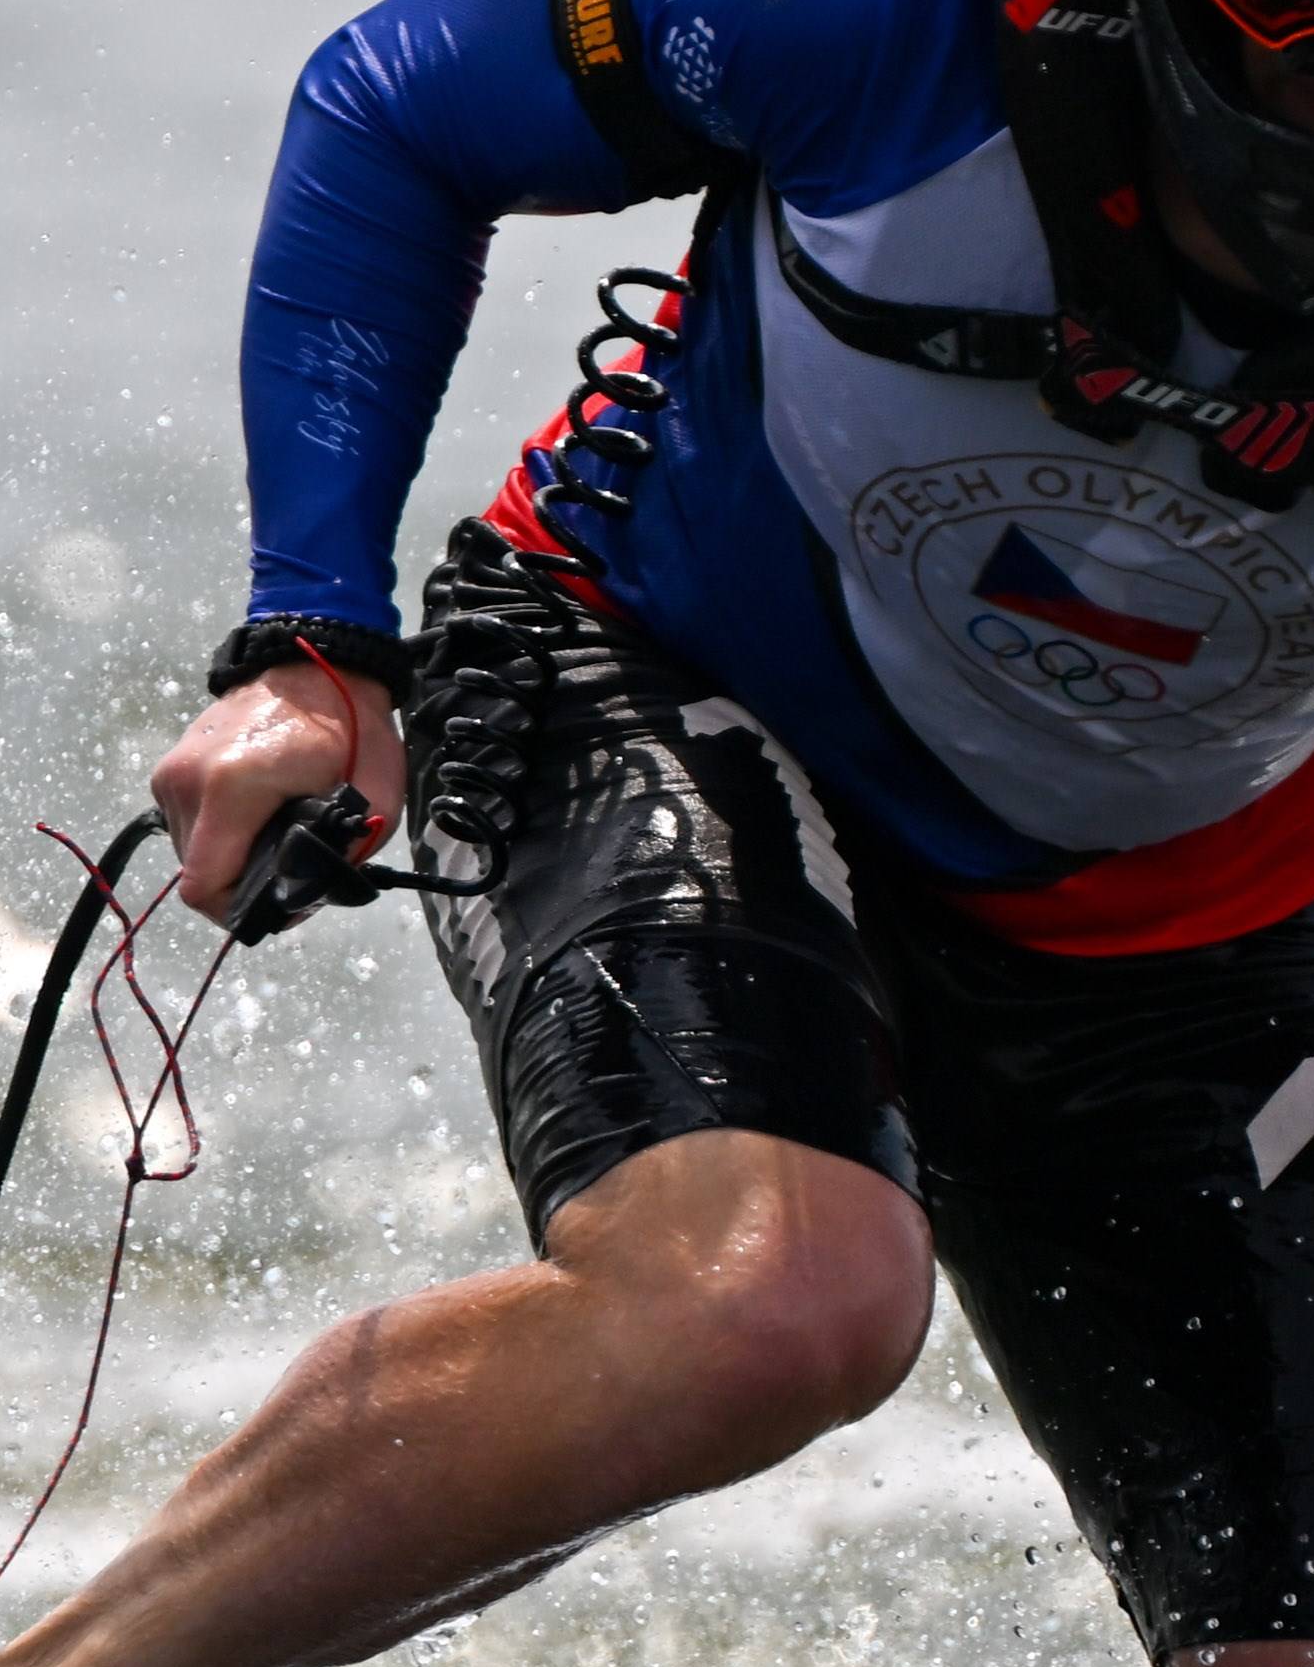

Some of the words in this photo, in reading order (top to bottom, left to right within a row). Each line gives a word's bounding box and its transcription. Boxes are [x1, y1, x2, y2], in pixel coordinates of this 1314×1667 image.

[1036, 7, 1133, 39] UFO
[1119, 377, 1239, 426] UFO
[861, 466, 1003, 558] CZECH
[1026, 464, 1293, 594] OLYMPIC
